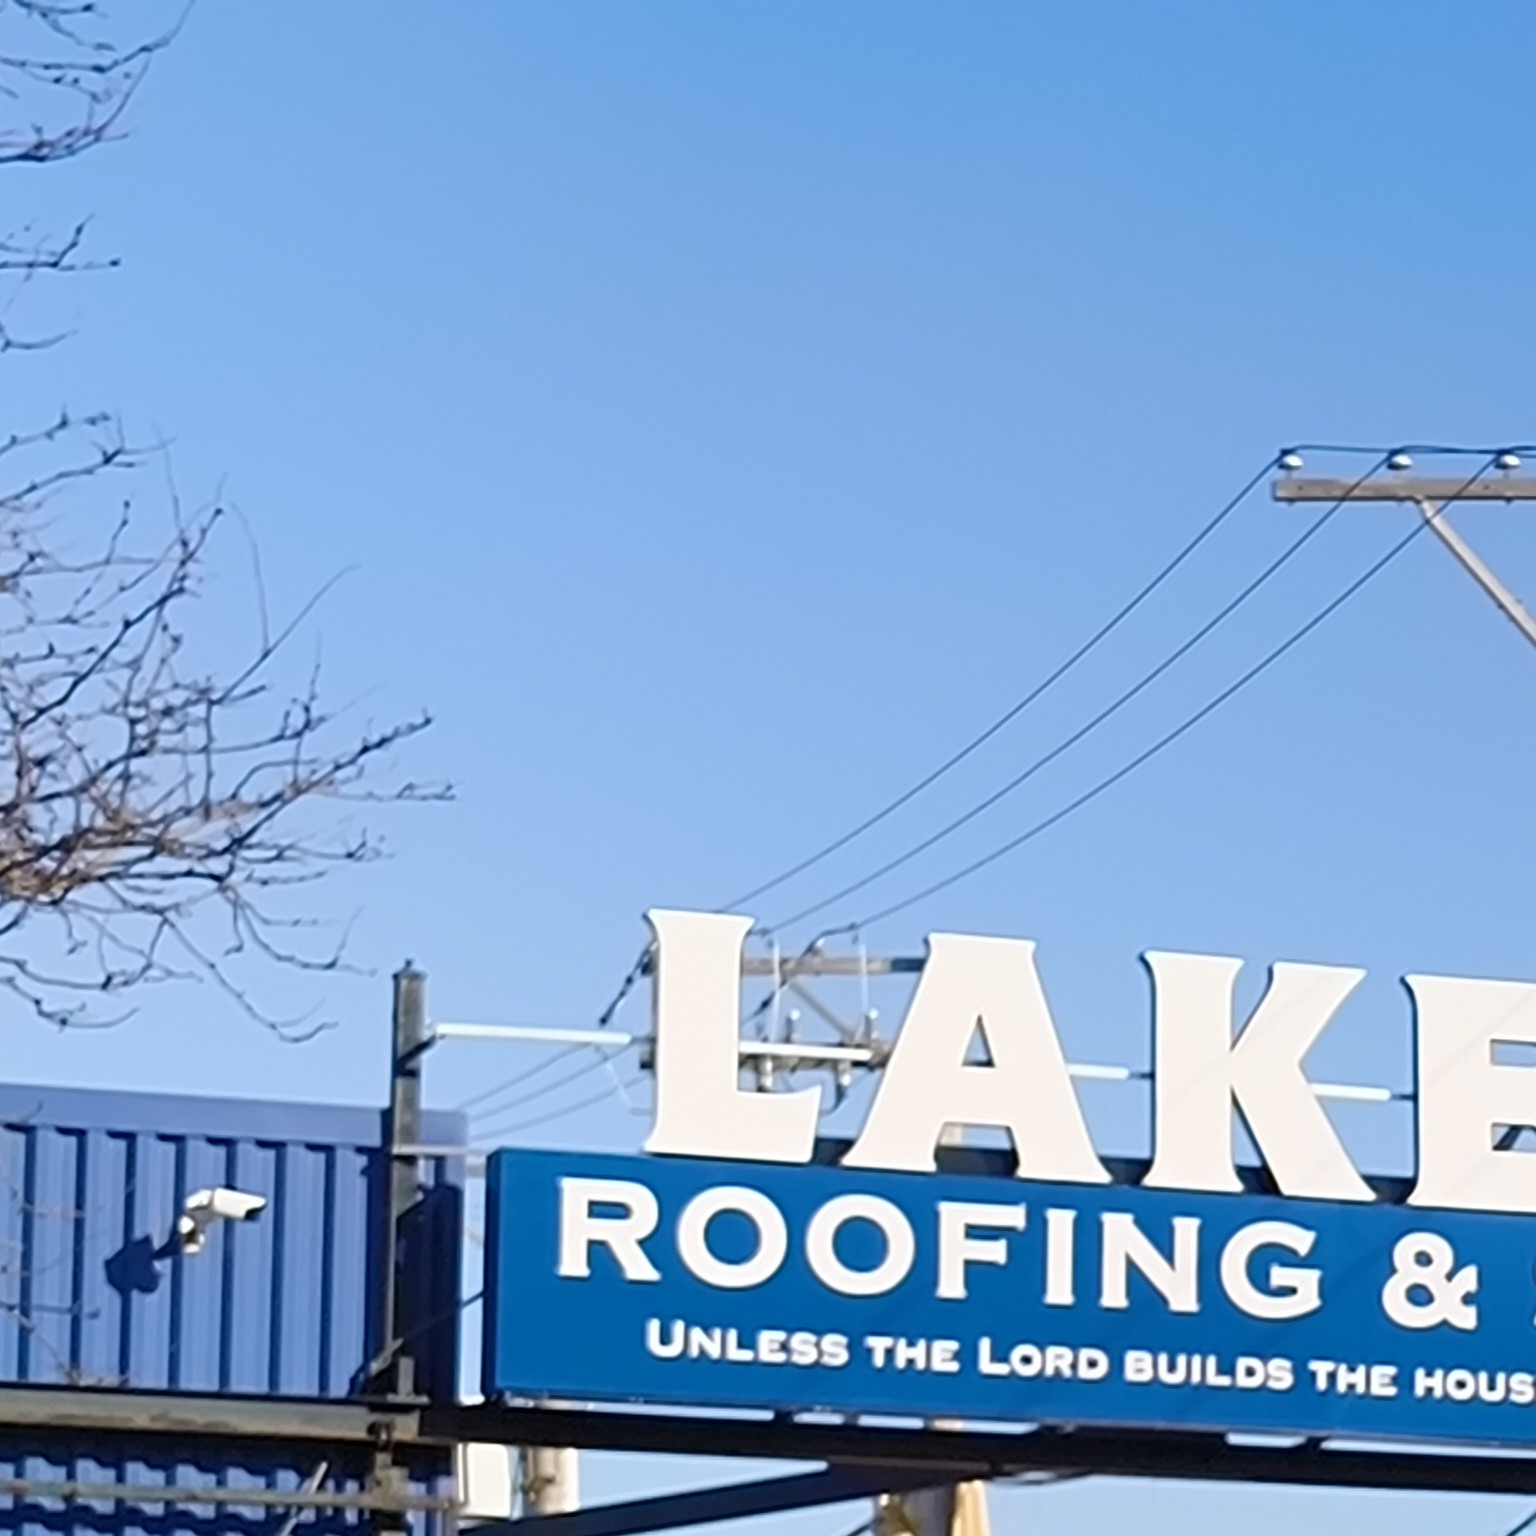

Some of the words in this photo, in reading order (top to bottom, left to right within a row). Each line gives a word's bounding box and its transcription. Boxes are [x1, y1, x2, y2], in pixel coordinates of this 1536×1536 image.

[557, 1176, 1322, 1321] ROOFING
[1381, 1231, 1479, 1331] &
[646, 1317, 850, 1369] UNLESS
[864, 1335, 961, 1373] THE
[977, 1336, 1110, 1381] LORD
[1123, 1349, 1295, 1391] BUILDS
[1307, 1359, 1399, 1398] THE
